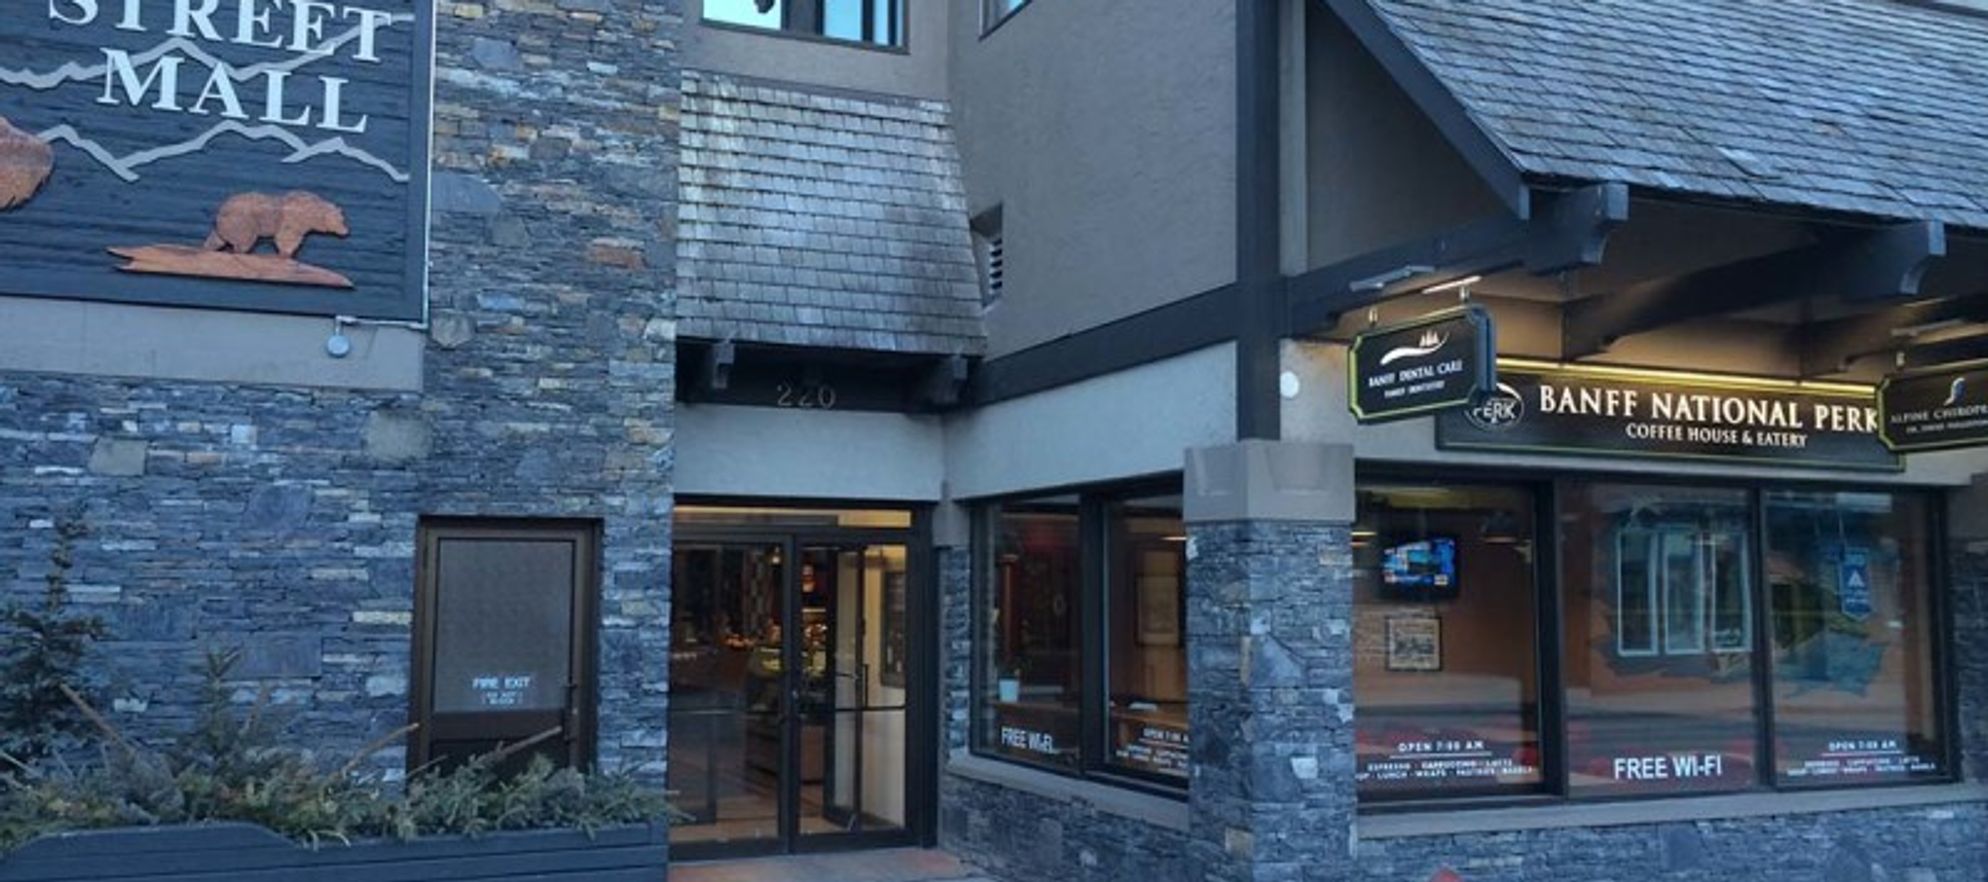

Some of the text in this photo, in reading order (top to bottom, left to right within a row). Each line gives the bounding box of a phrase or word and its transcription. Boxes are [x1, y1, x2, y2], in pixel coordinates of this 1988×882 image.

[97, 47, 369, 134] MALL
[1399, 365, 1435, 382] DENTAL
[1437, 359, 1463, 375] CARE
[1538, 384, 1638, 418] BANFF
[1650, 391, 1804, 429] NATIONAL
[1813, 404, 1878, 433] PERK
[1625, 422, 1808, 448] COFFEE HOUSE & EATERY
[504, 676, 531, 689] EXIT
[1001, 725, 1027, 749] FREE
[1399, 741, 1432, 752] OPEN
[1465, 740, 1485, 750] AM
[1614, 754, 1722, 780] FREE WI-FI
